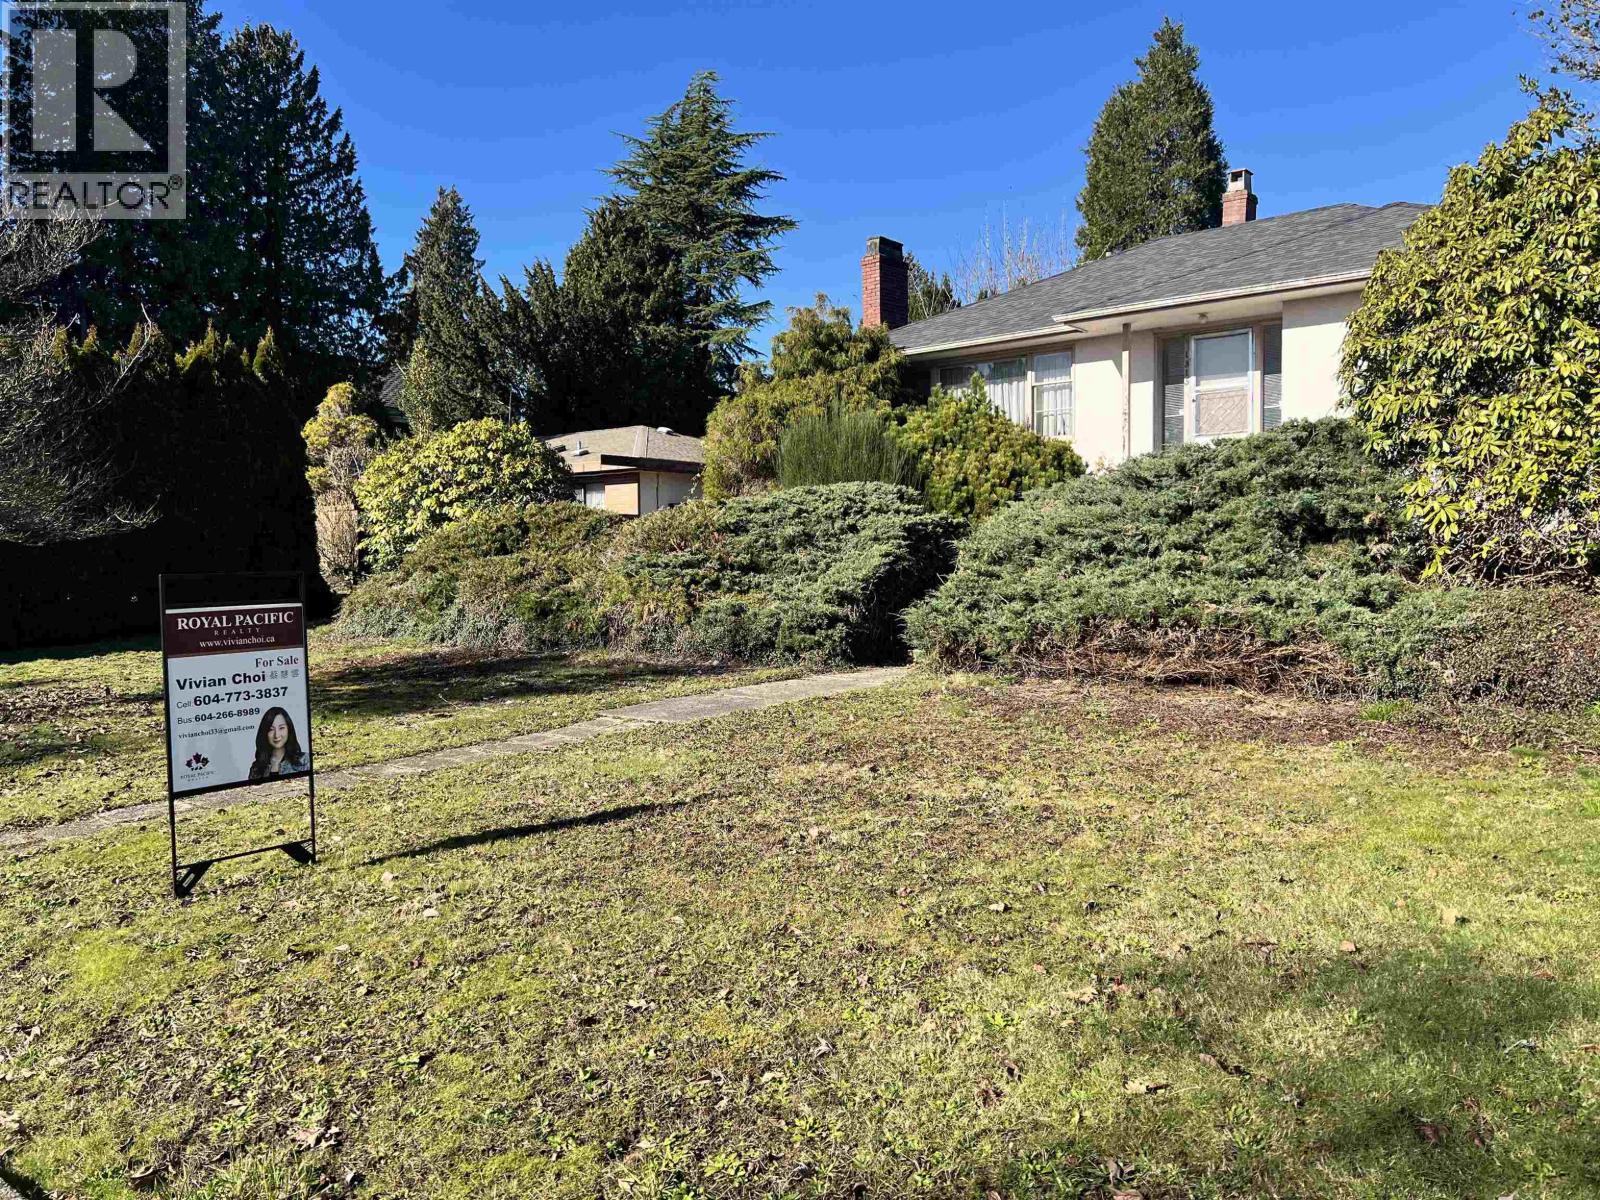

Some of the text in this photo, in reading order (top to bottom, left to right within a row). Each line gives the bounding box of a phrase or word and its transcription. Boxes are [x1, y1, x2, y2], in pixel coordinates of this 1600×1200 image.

[177, 611, 294, 630] ROYAL PACIFIC
[214, 627, 261, 636] REALTY
[199, 635, 275, 648] www.vivianchoi.ca
[255, 655, 299, 668] For Sale
[176, 676, 227, 691] Vivian
[231, 671, 266, 685] Choi
[193, 686, 288, 707] 604-773-3837
[194, 707, 260, 723] 604-266-8989
